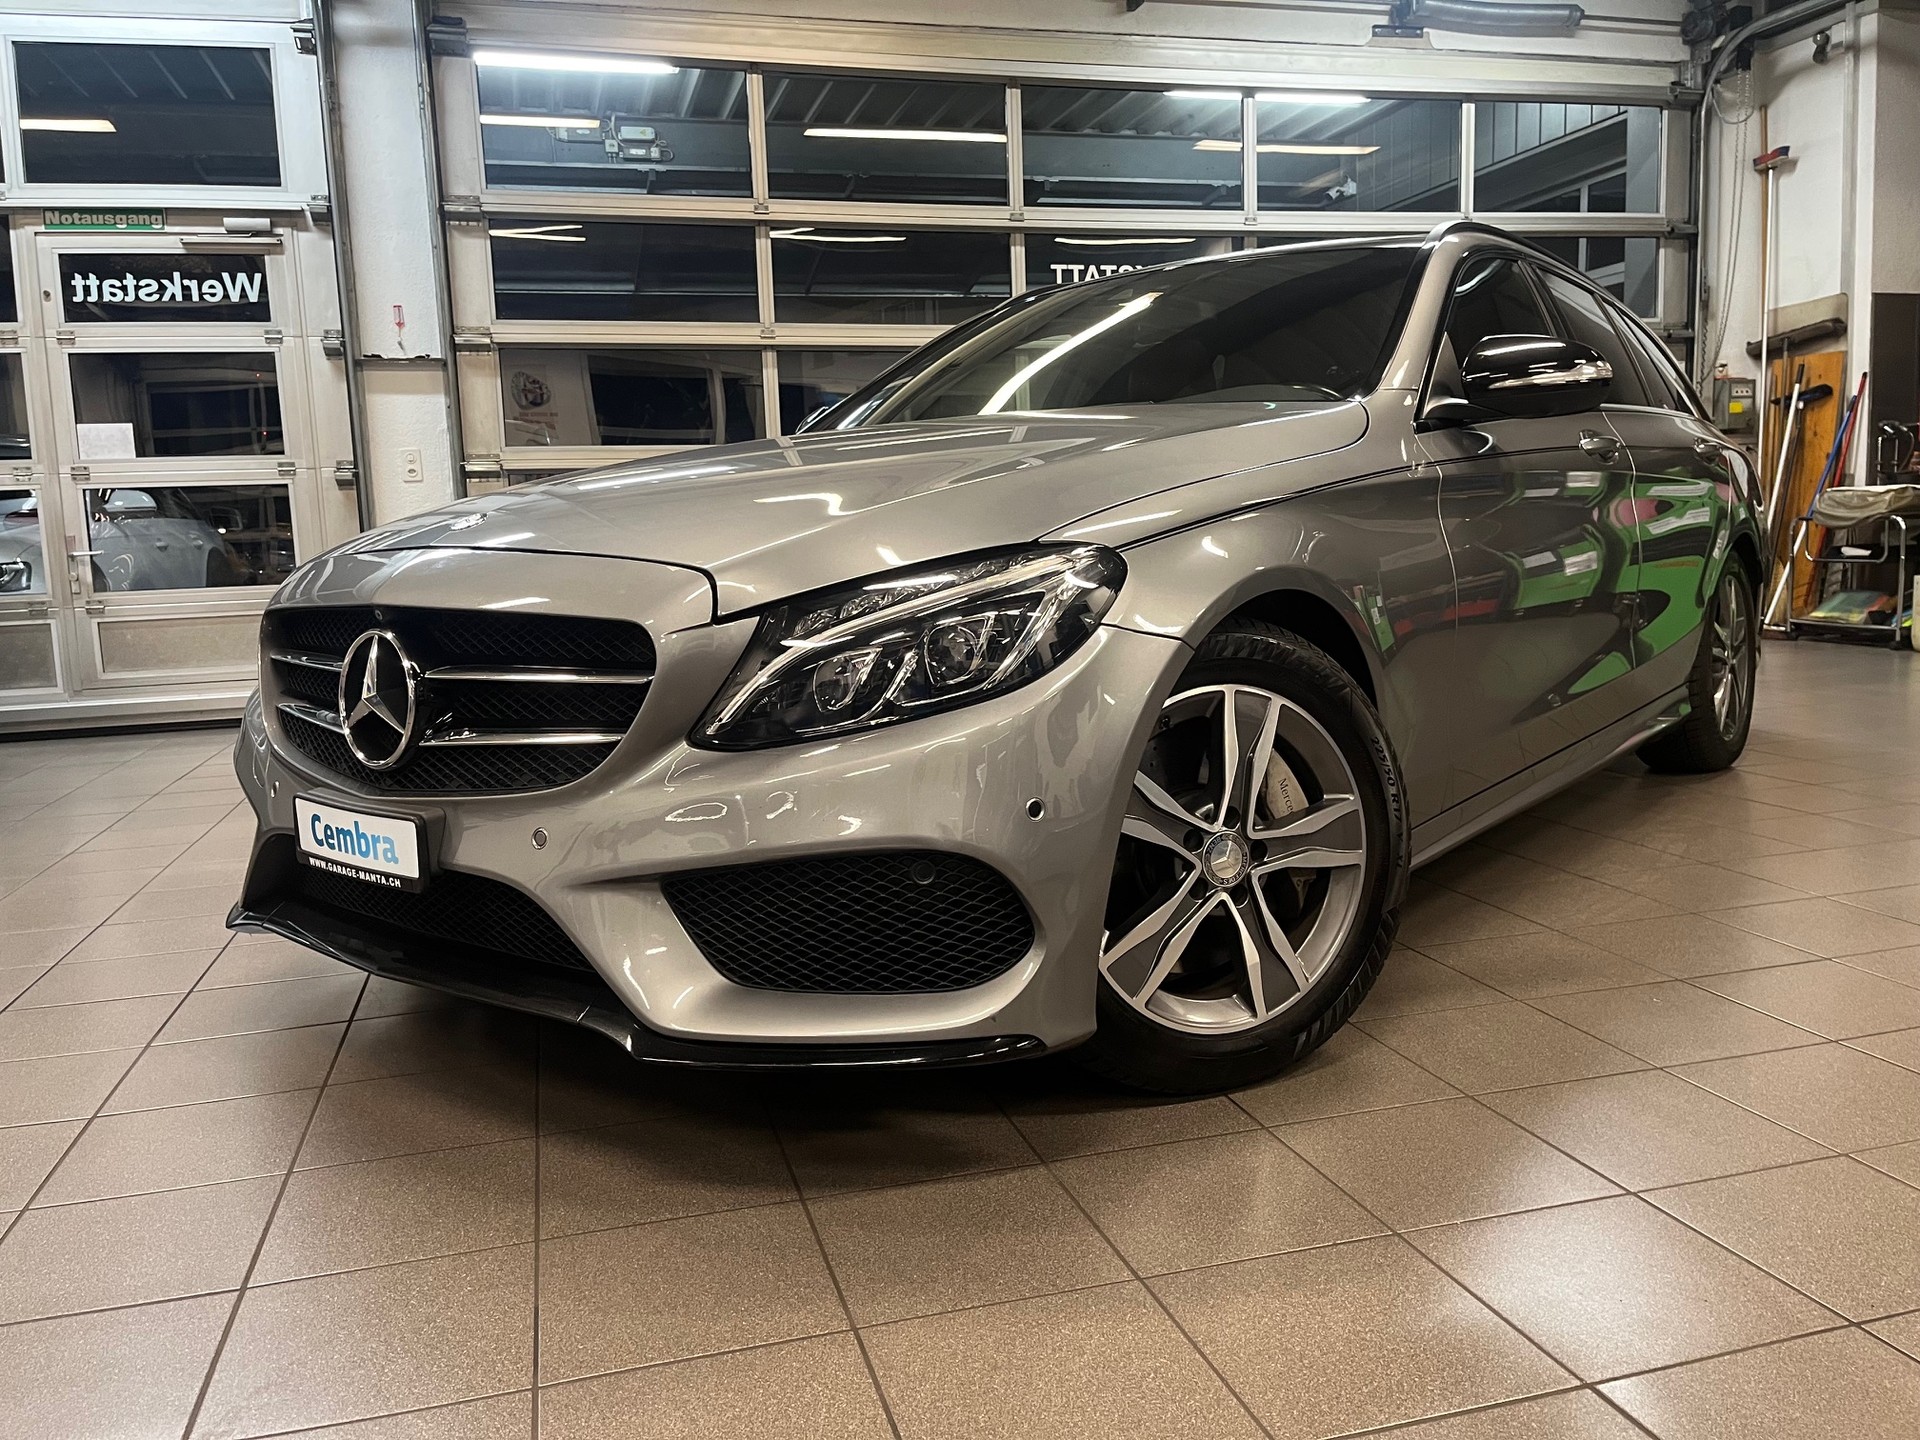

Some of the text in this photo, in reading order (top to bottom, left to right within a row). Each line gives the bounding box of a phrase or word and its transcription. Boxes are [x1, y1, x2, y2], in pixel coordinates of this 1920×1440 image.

[44, 210, 163, 229] Notausgang
[1370, 736, 1396, 788] 225/50
[311, 813, 399, 865] Cembra
[308, 856, 402, 888] WWW.GARAGE-MANTA.CH
